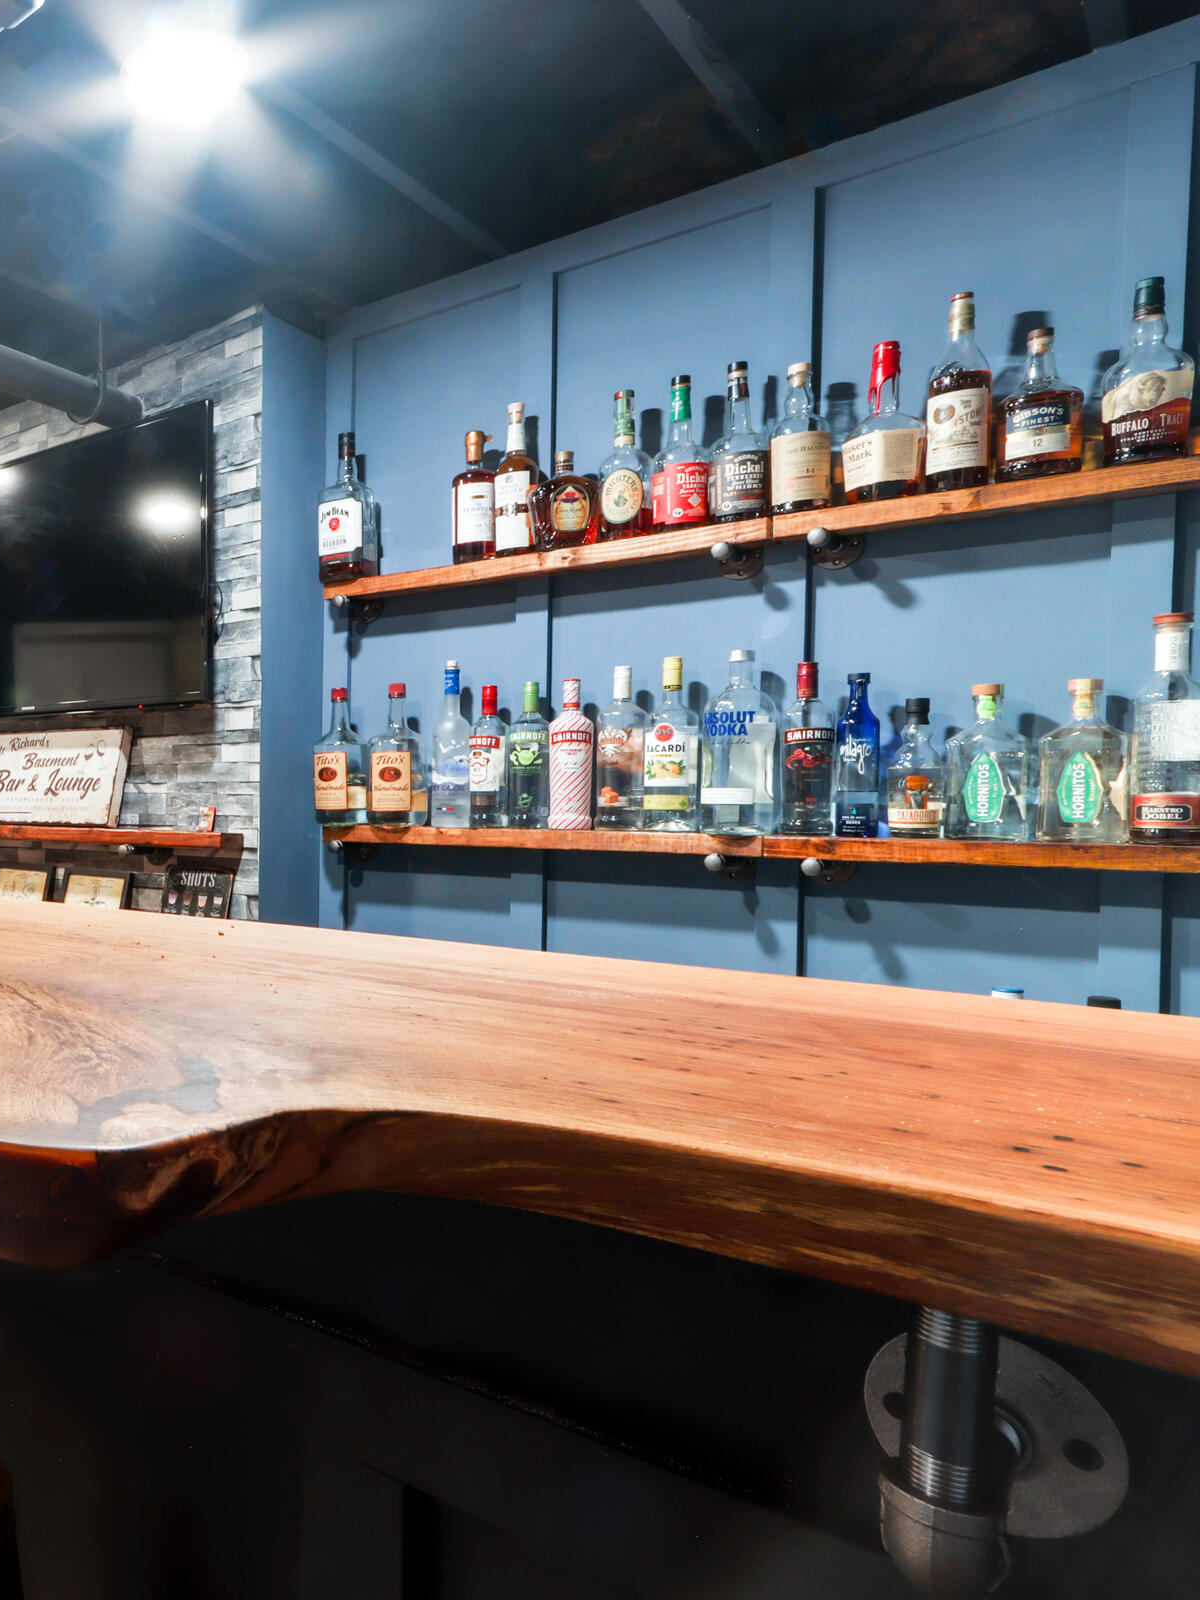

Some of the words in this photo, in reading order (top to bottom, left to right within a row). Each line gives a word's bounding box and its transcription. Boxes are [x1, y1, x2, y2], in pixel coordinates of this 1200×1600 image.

[1013, 405, 1064, 423] GIBSON'S
[1020, 415, 1055, 427] FINEST
[1111, 417, 1150, 437] BUFFALO
[1032, 438, 1043, 448] 12
[848, 449, 872, 464] Mark
[724, 460, 764, 477] Dickel
[320, 510, 331, 524] JIM
[331, 506, 349, 519] BEAM
[704, 710, 755, 725] ABSOLUT
[510, 731, 546, 741] SMIRNOFF
[552, 732, 590, 742] SMIRNOFF
[705, 723, 748, 737] VODKA
[9, 735, 50, 752] Richard's
[22, 752, 80, 771] Basement
[315, 754, 341, 766] Tito's
[375, 754, 405, 766] Tito's
[27, 773, 39, 792] &
[44, 768, 102, 800] Lounge
[373, 783, 410, 792] Handmade
[977, 763, 990, 817] HORNITOS
[1072, 763, 1085, 819] HORNITOS
[1142, 806, 1184, 814] MAESTRO
[1142, 812, 1183, 820] DOBEL
[180, 870, 217, 888] SHOTS
